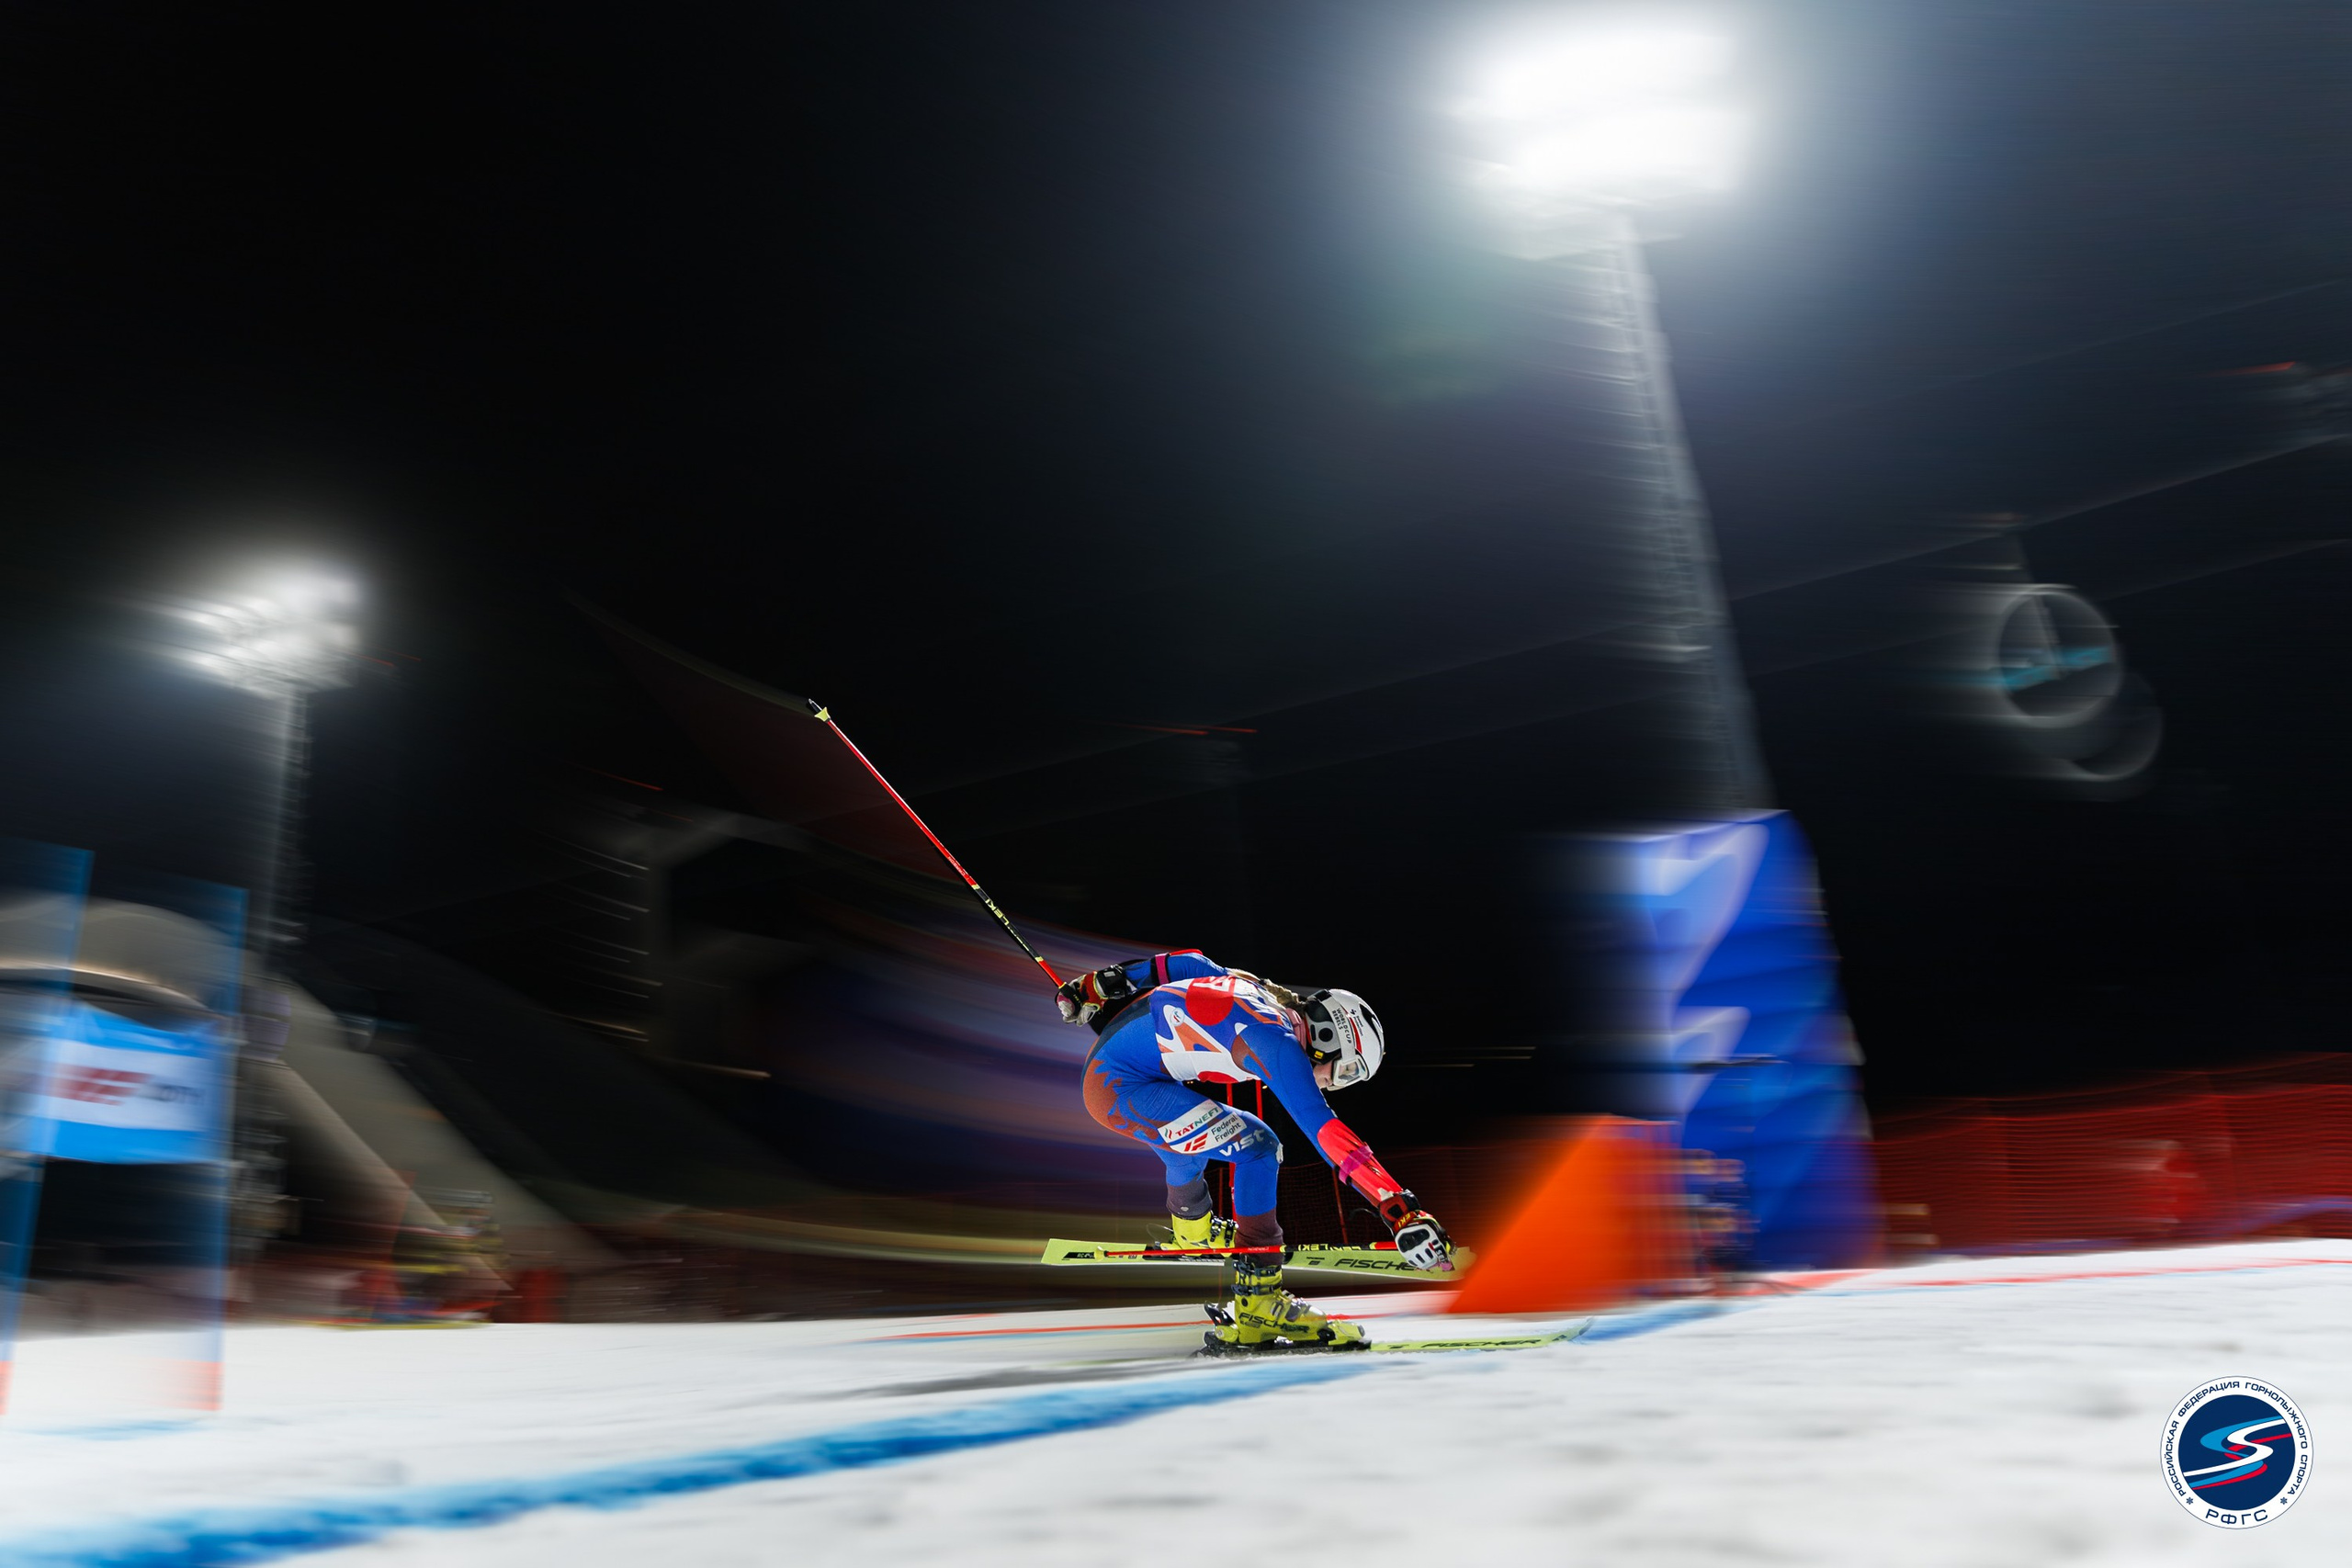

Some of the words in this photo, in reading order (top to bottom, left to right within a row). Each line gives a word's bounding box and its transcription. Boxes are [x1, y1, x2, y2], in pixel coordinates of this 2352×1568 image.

[985, 898, 1010, 926] LEKI
[1175, 1107, 1219, 1136] TATNEFT
[1211, 1114, 1238, 1135] Federal
[1215, 1122, 1241, 1142] Freight
[1397, 1213, 1411, 1228] EKI
[1334, 1258, 1416, 1271] FISCHE
